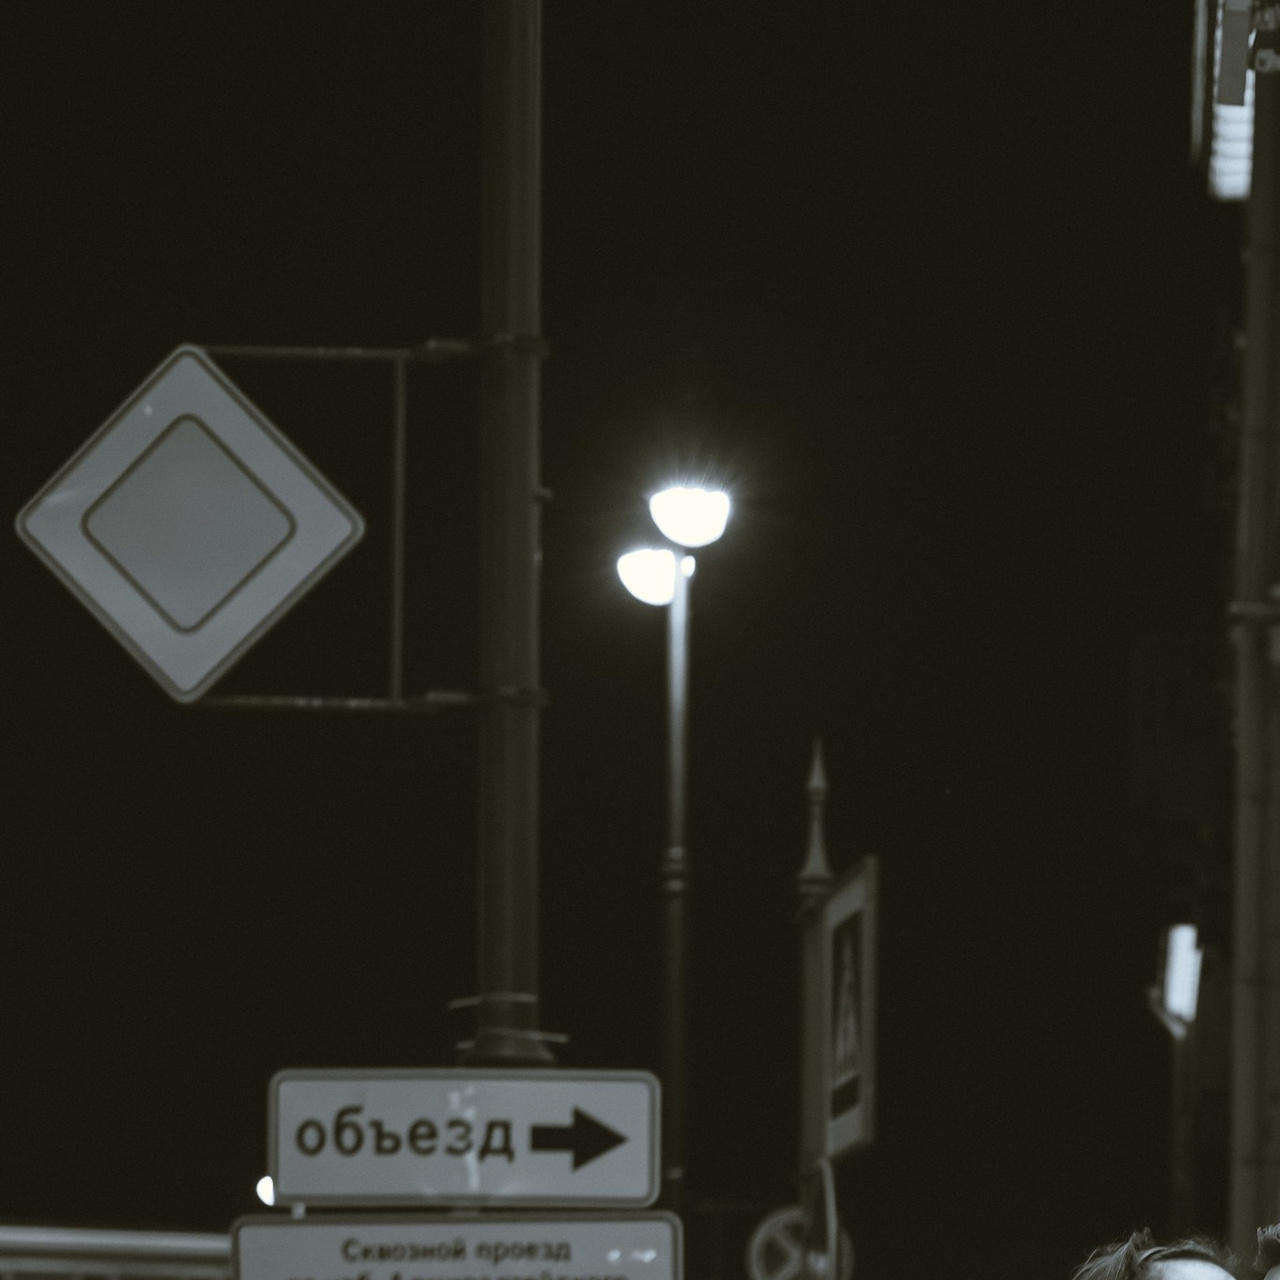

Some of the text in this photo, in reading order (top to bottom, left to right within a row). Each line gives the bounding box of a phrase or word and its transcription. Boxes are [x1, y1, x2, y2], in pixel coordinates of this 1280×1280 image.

[296, 1104, 515, 1163] объезд
[341, 1237, 573, 1266] Сквозной проезд
